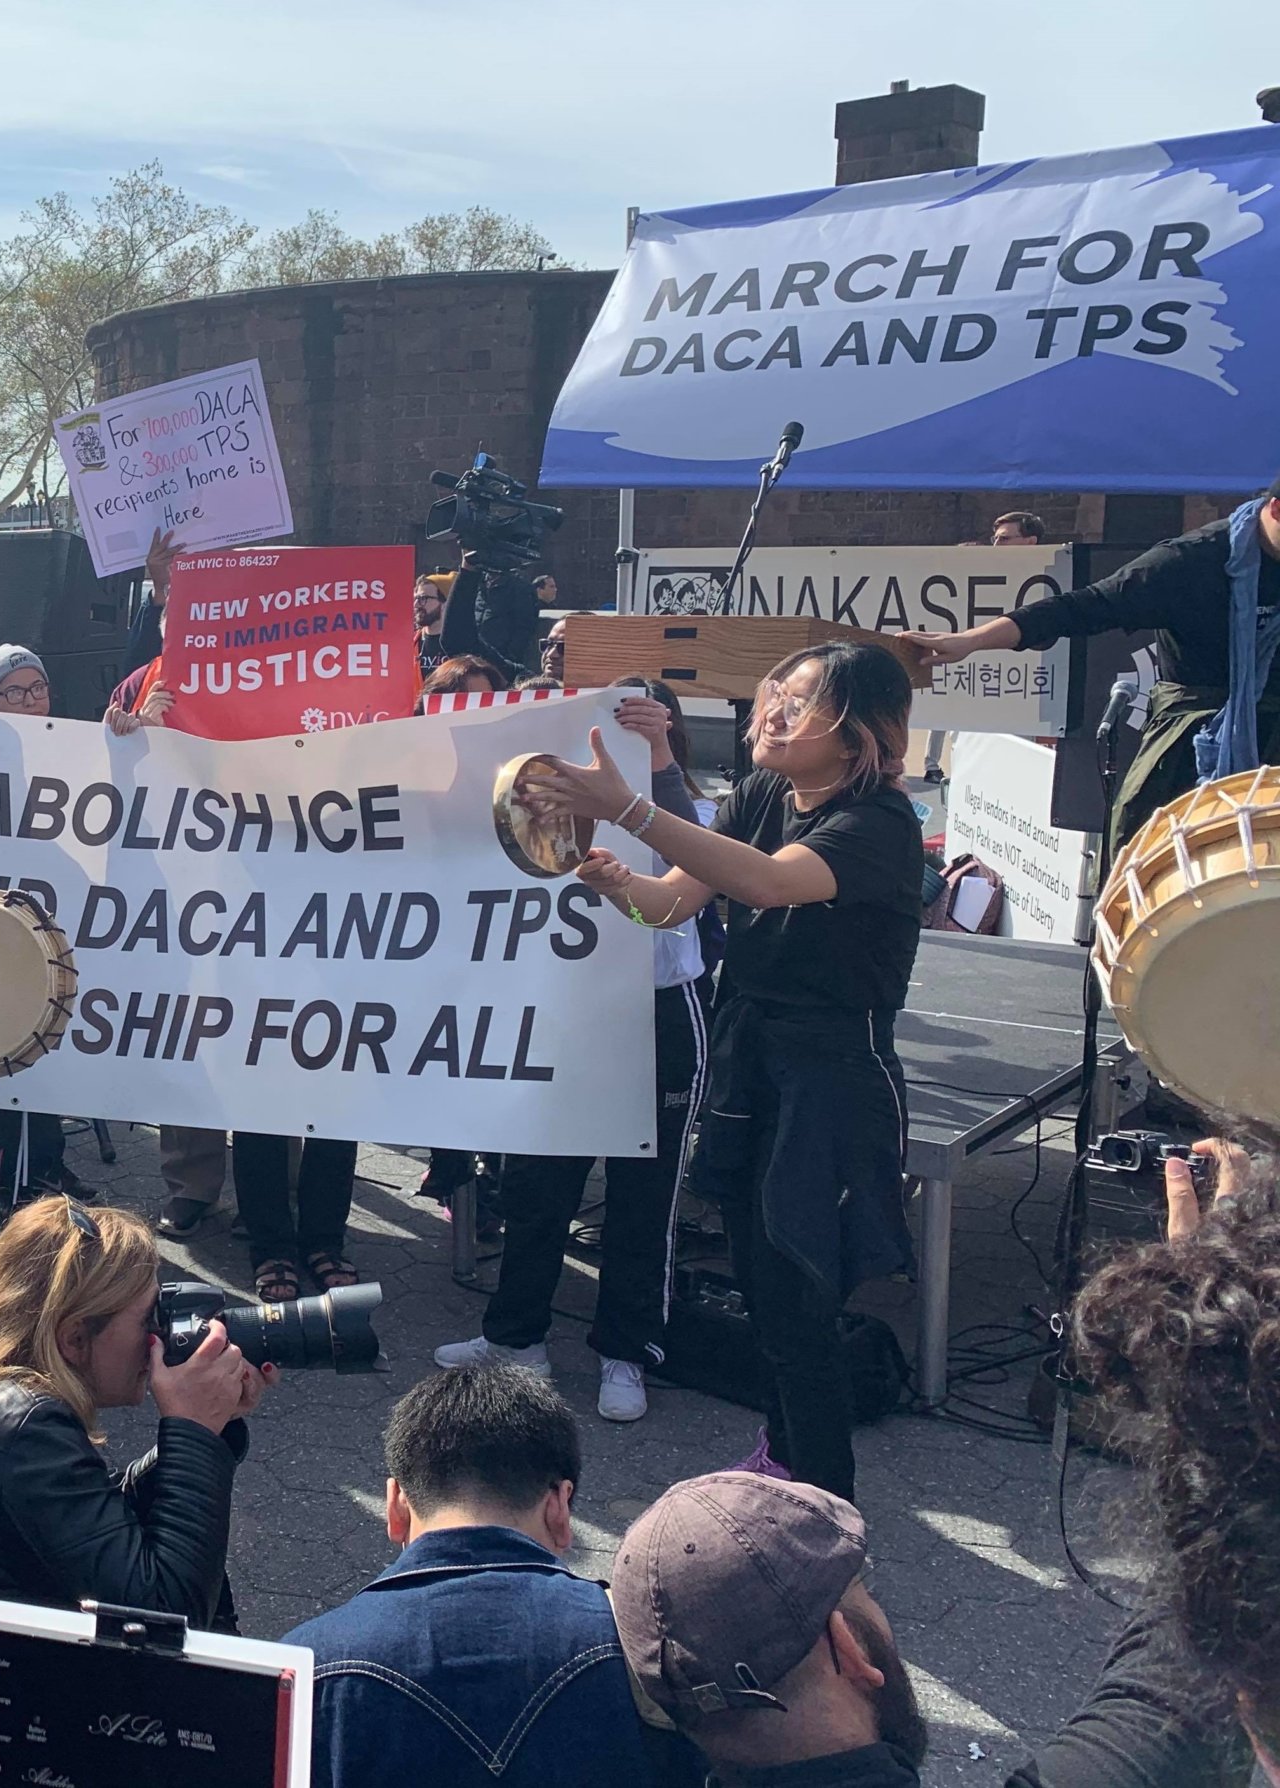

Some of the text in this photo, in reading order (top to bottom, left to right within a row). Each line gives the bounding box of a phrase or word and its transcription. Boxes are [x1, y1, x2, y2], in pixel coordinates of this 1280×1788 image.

[643, 221, 1211, 322] MARCH FOR
[619, 300, 1193, 378] DACA AND TPS
[107, 414, 139, 450] For
[195, 384, 261, 425] DACA
[119, 420, 250, 486] & 300,000 TPS
[94, 457, 266, 520] recipients home is
[164, 504, 205, 529] Here
[176, 555, 280, 571] Text NYIC to 864237
[184, 612, 389, 648] FOR IMMIGRANT
[189, 580, 386, 621] NEW YORKERS
[179, 643, 389, 695] JUSTICE!
[933, 663, 1055, 700] 단체협의회
[288, 785, 405, 853] ICE
[965, 785, 1060, 853] Illegal vendors in and around
[953, 813, 1070, 901] Battery Park are NOT authorized to
[75, 885, 266, 958] DACA
[280, 892, 441, 960] AND
[467, 883, 602, 961] TPS
[1021, 892, 1031, 914] of
[1030, 895, 1056, 939] Liberty
[245, 998, 397, 1074] FOR
[408, 1004, 554, 1081] ALL
